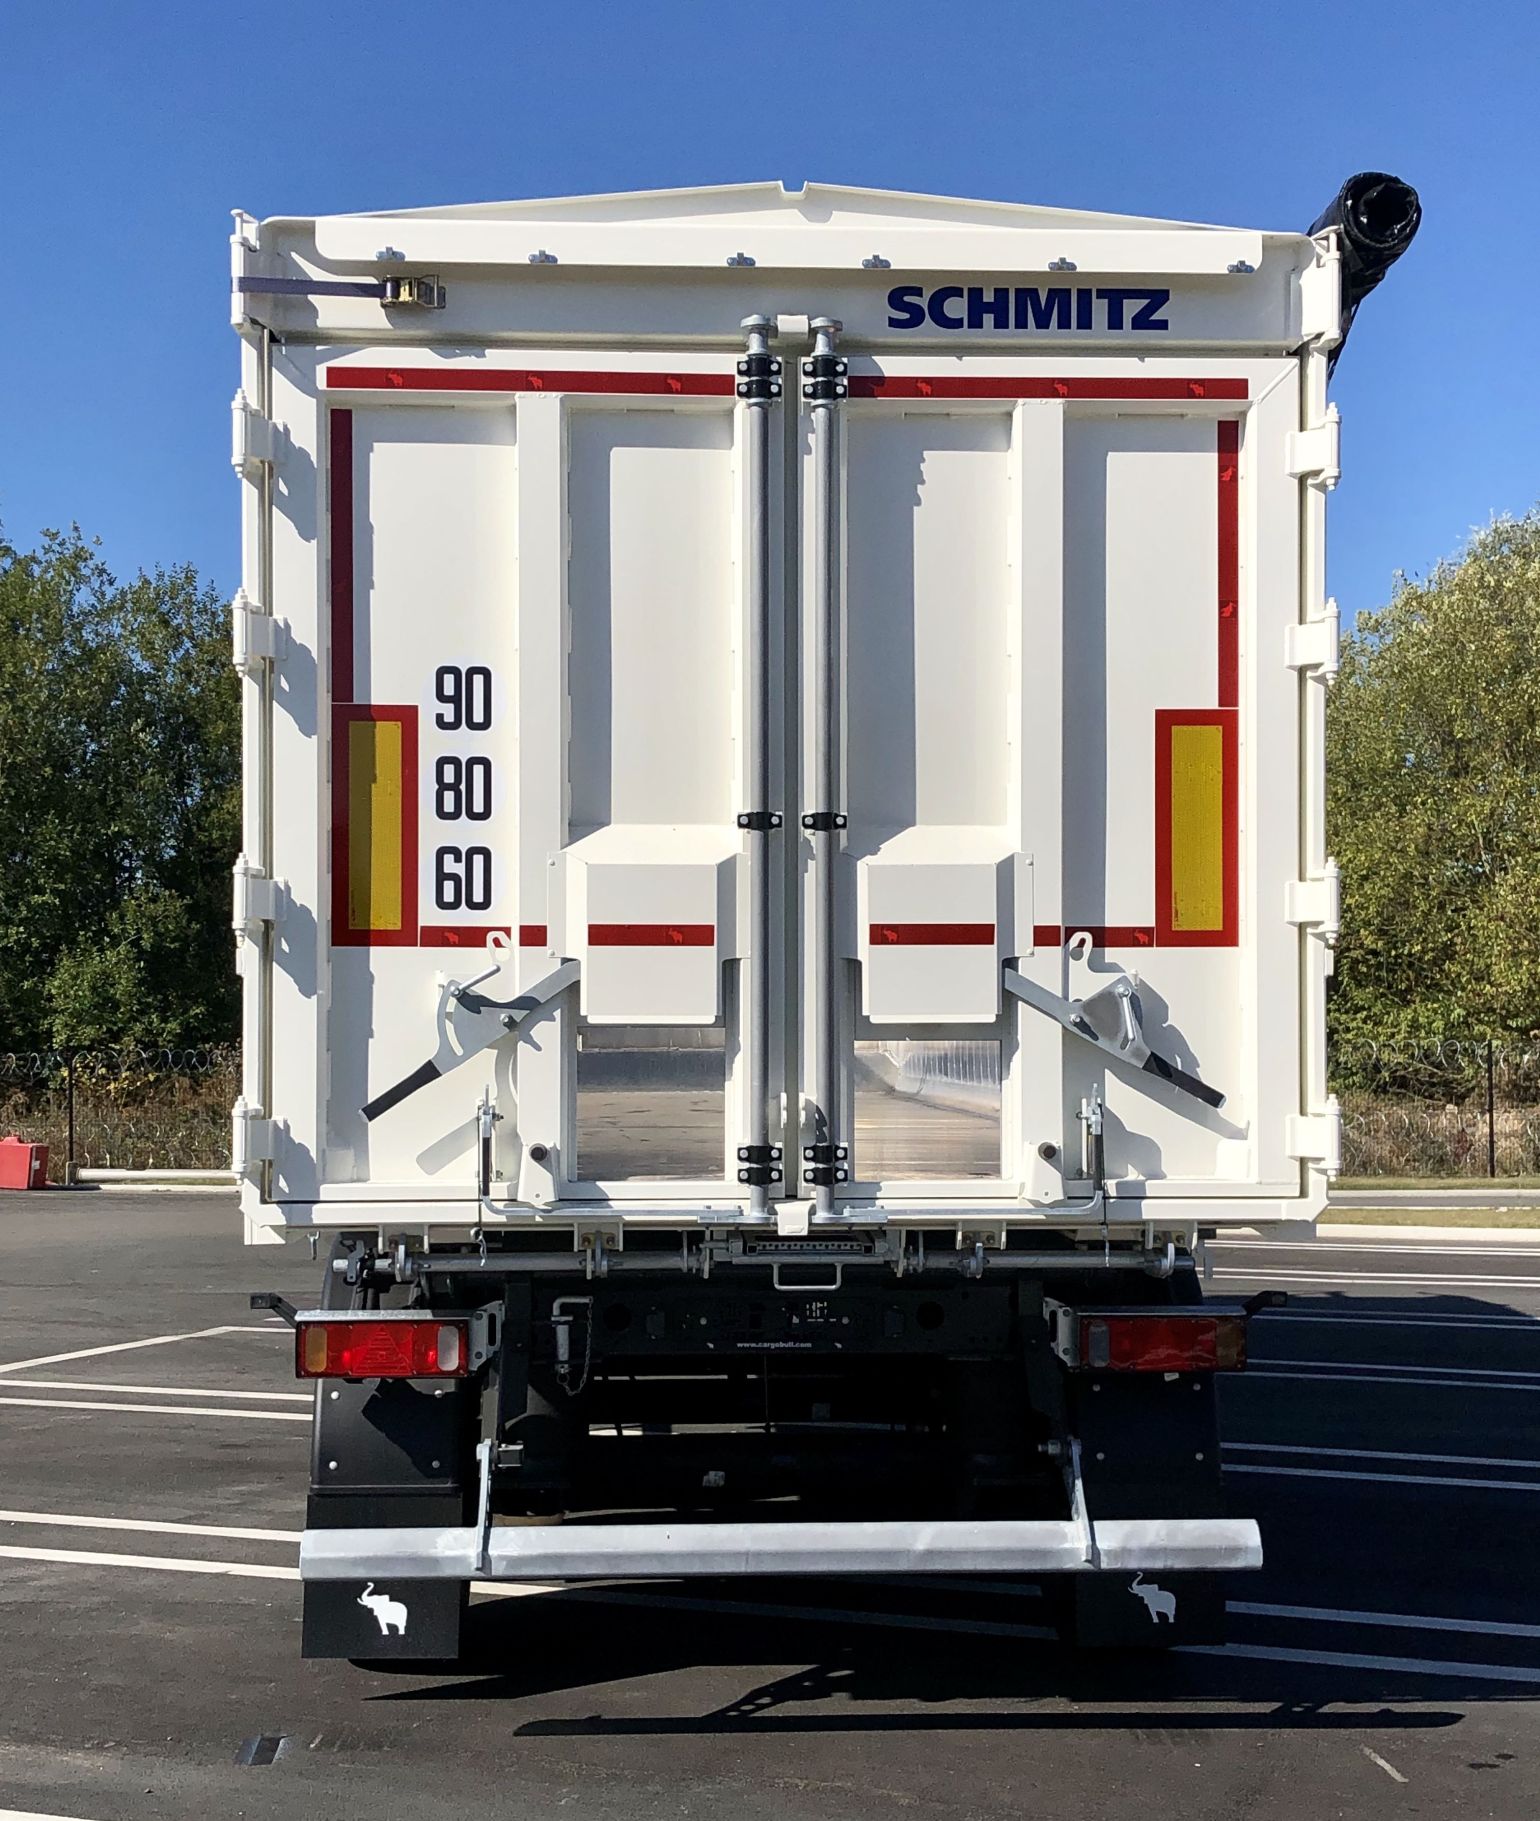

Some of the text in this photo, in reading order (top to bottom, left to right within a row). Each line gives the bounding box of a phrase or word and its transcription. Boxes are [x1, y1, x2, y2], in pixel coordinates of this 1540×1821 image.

[887, 285, 1170, 331] SCHMITZ
[435, 665, 492, 731] 90
[435, 755, 492, 821] 80
[435, 845, 492, 911] 60
[736, 1341, 812, 1349] www.cargobull.com
